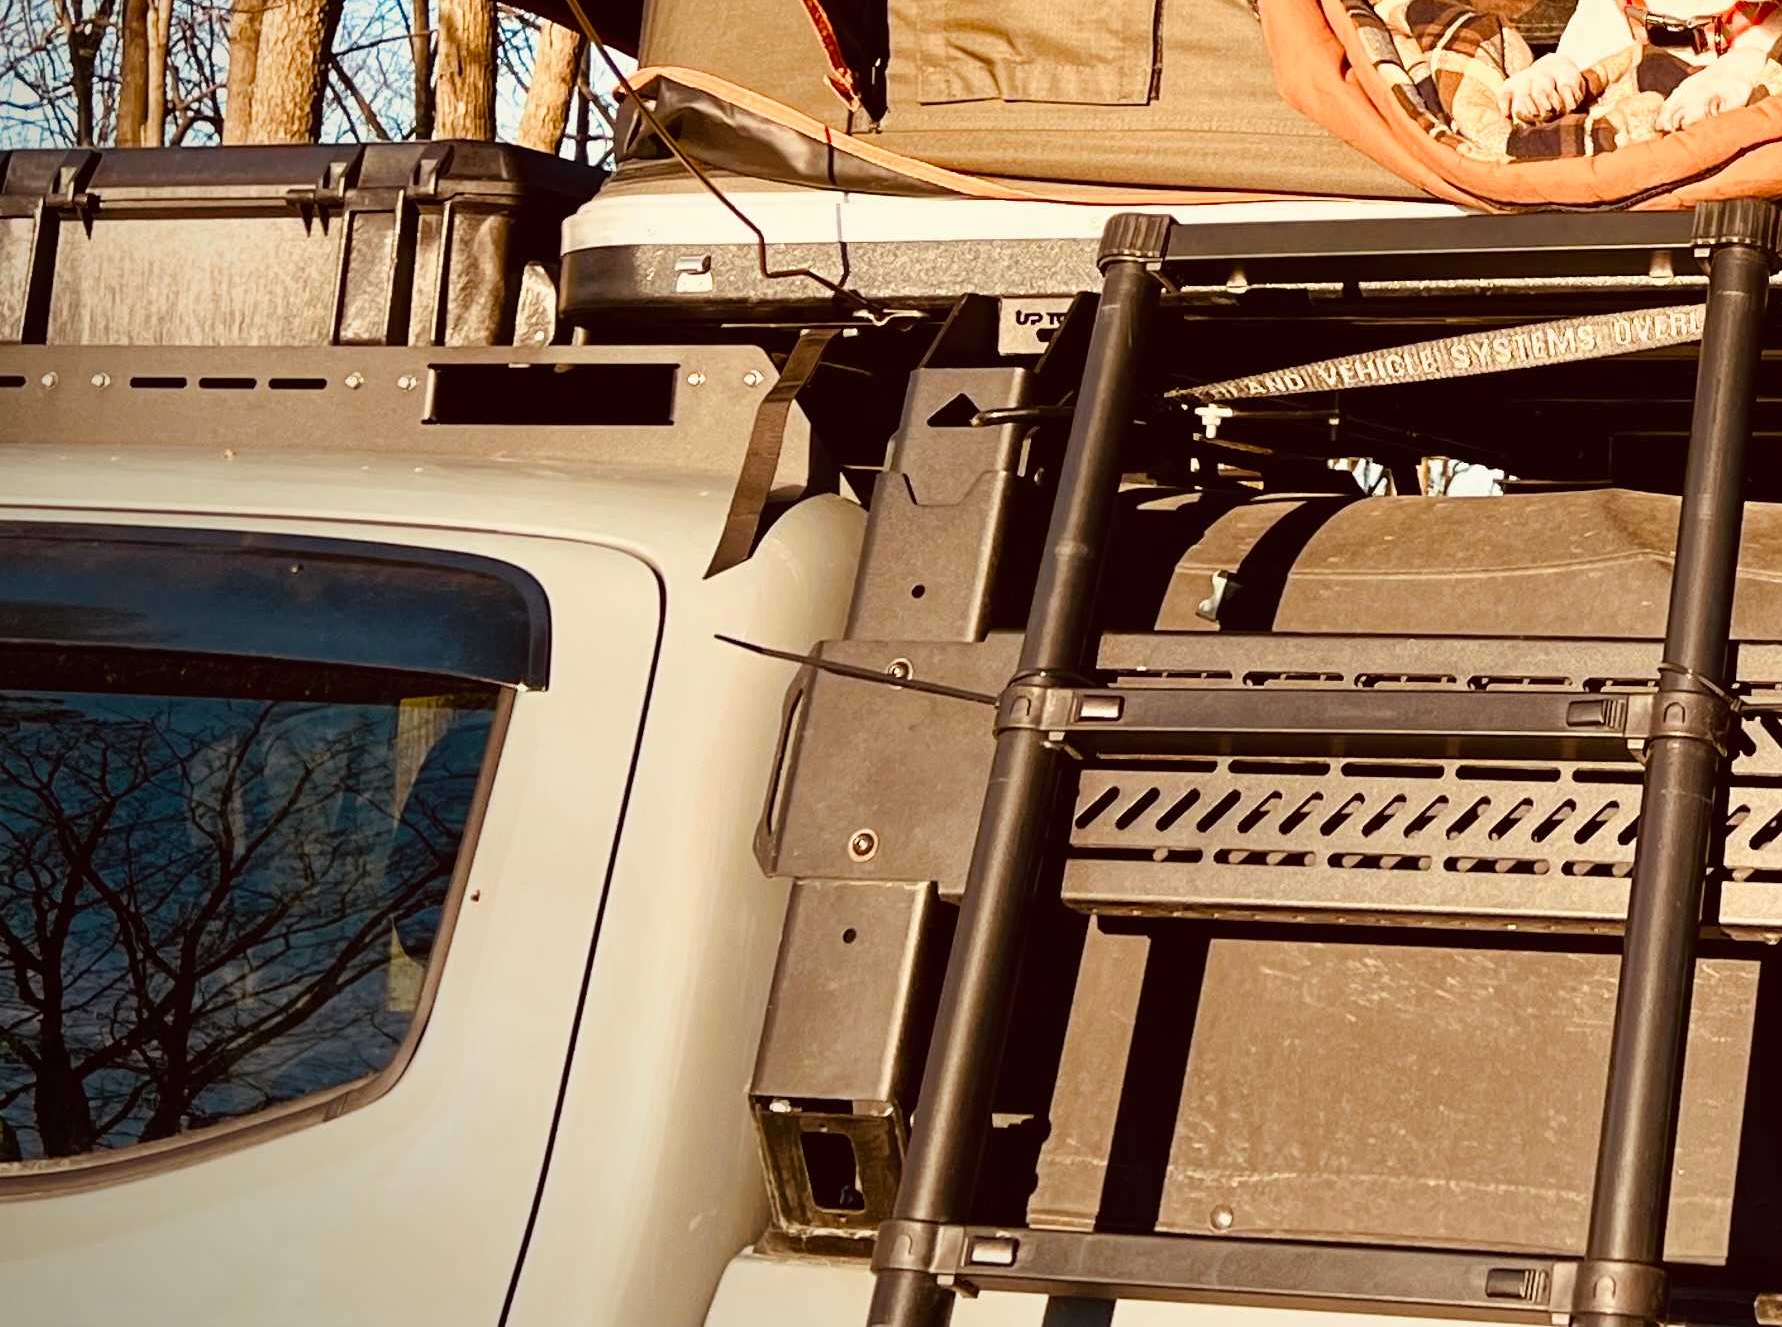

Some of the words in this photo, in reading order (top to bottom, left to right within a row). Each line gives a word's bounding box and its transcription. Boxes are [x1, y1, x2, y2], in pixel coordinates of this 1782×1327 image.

[1016, 310, 1043, 325] UP
[1319, 352, 1441, 387] VEHICLE
[1450, 324, 1598, 370] SYSTEMS
[1614, 311, 1701, 345] OVERL
